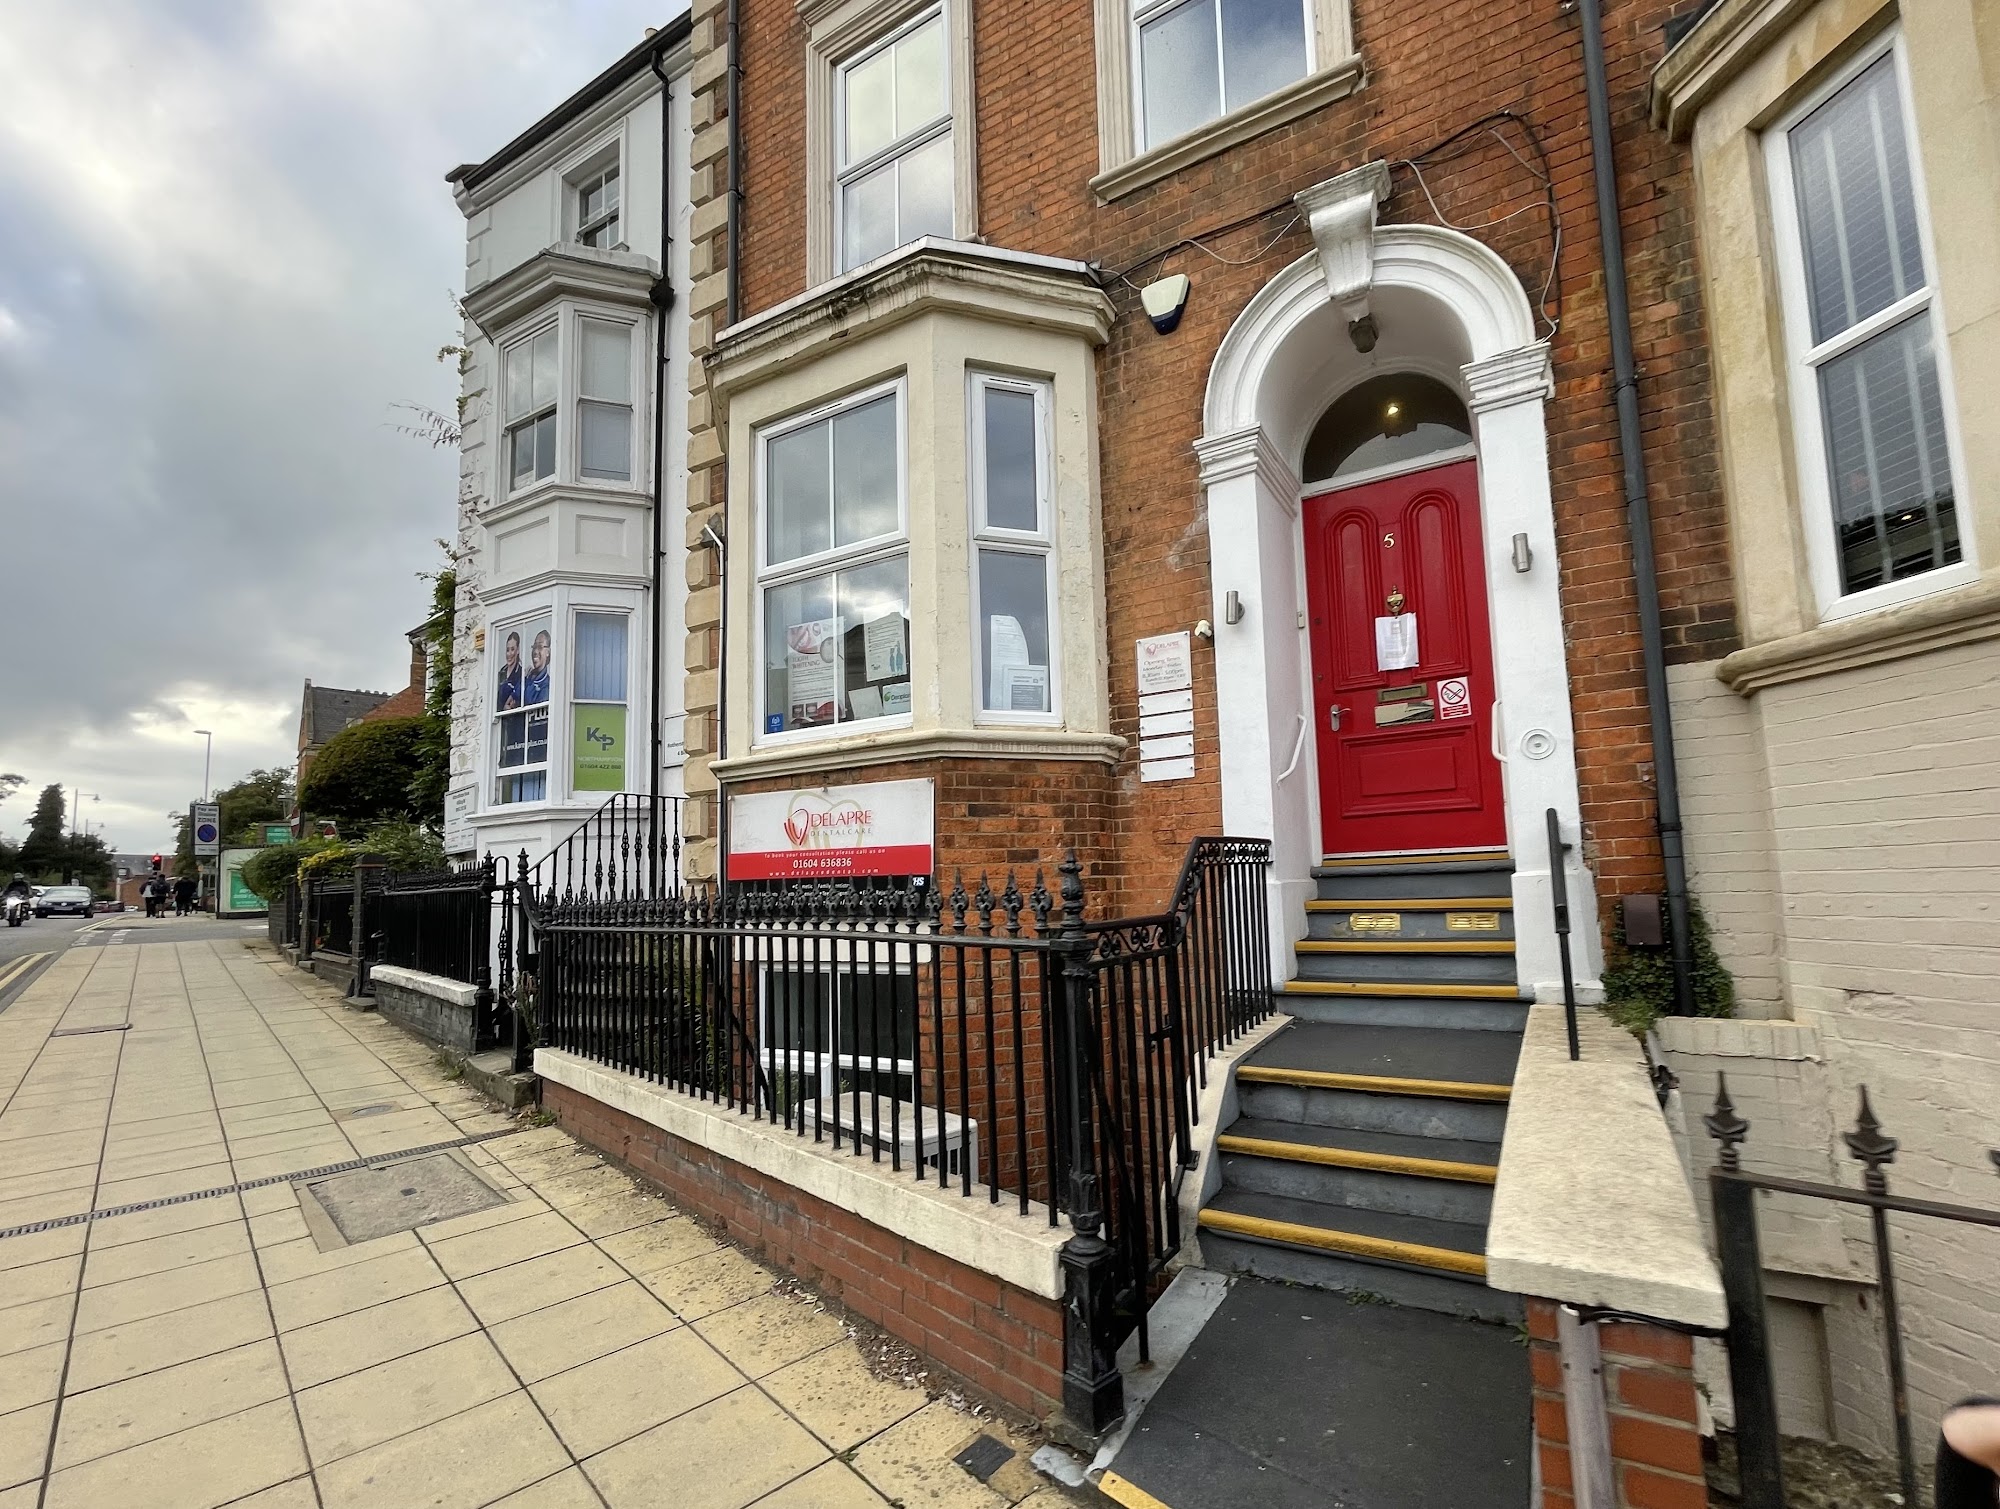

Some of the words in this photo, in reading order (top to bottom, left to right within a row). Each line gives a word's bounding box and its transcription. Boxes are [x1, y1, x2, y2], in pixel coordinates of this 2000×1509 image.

[1384, 532, 1395, 549] 5
[792, 660, 821, 669] WHITENING
[811, 810, 872, 828] DELAPRE
[793, 859, 818, 869] 01604
[820, 857, 852, 868] 636836
